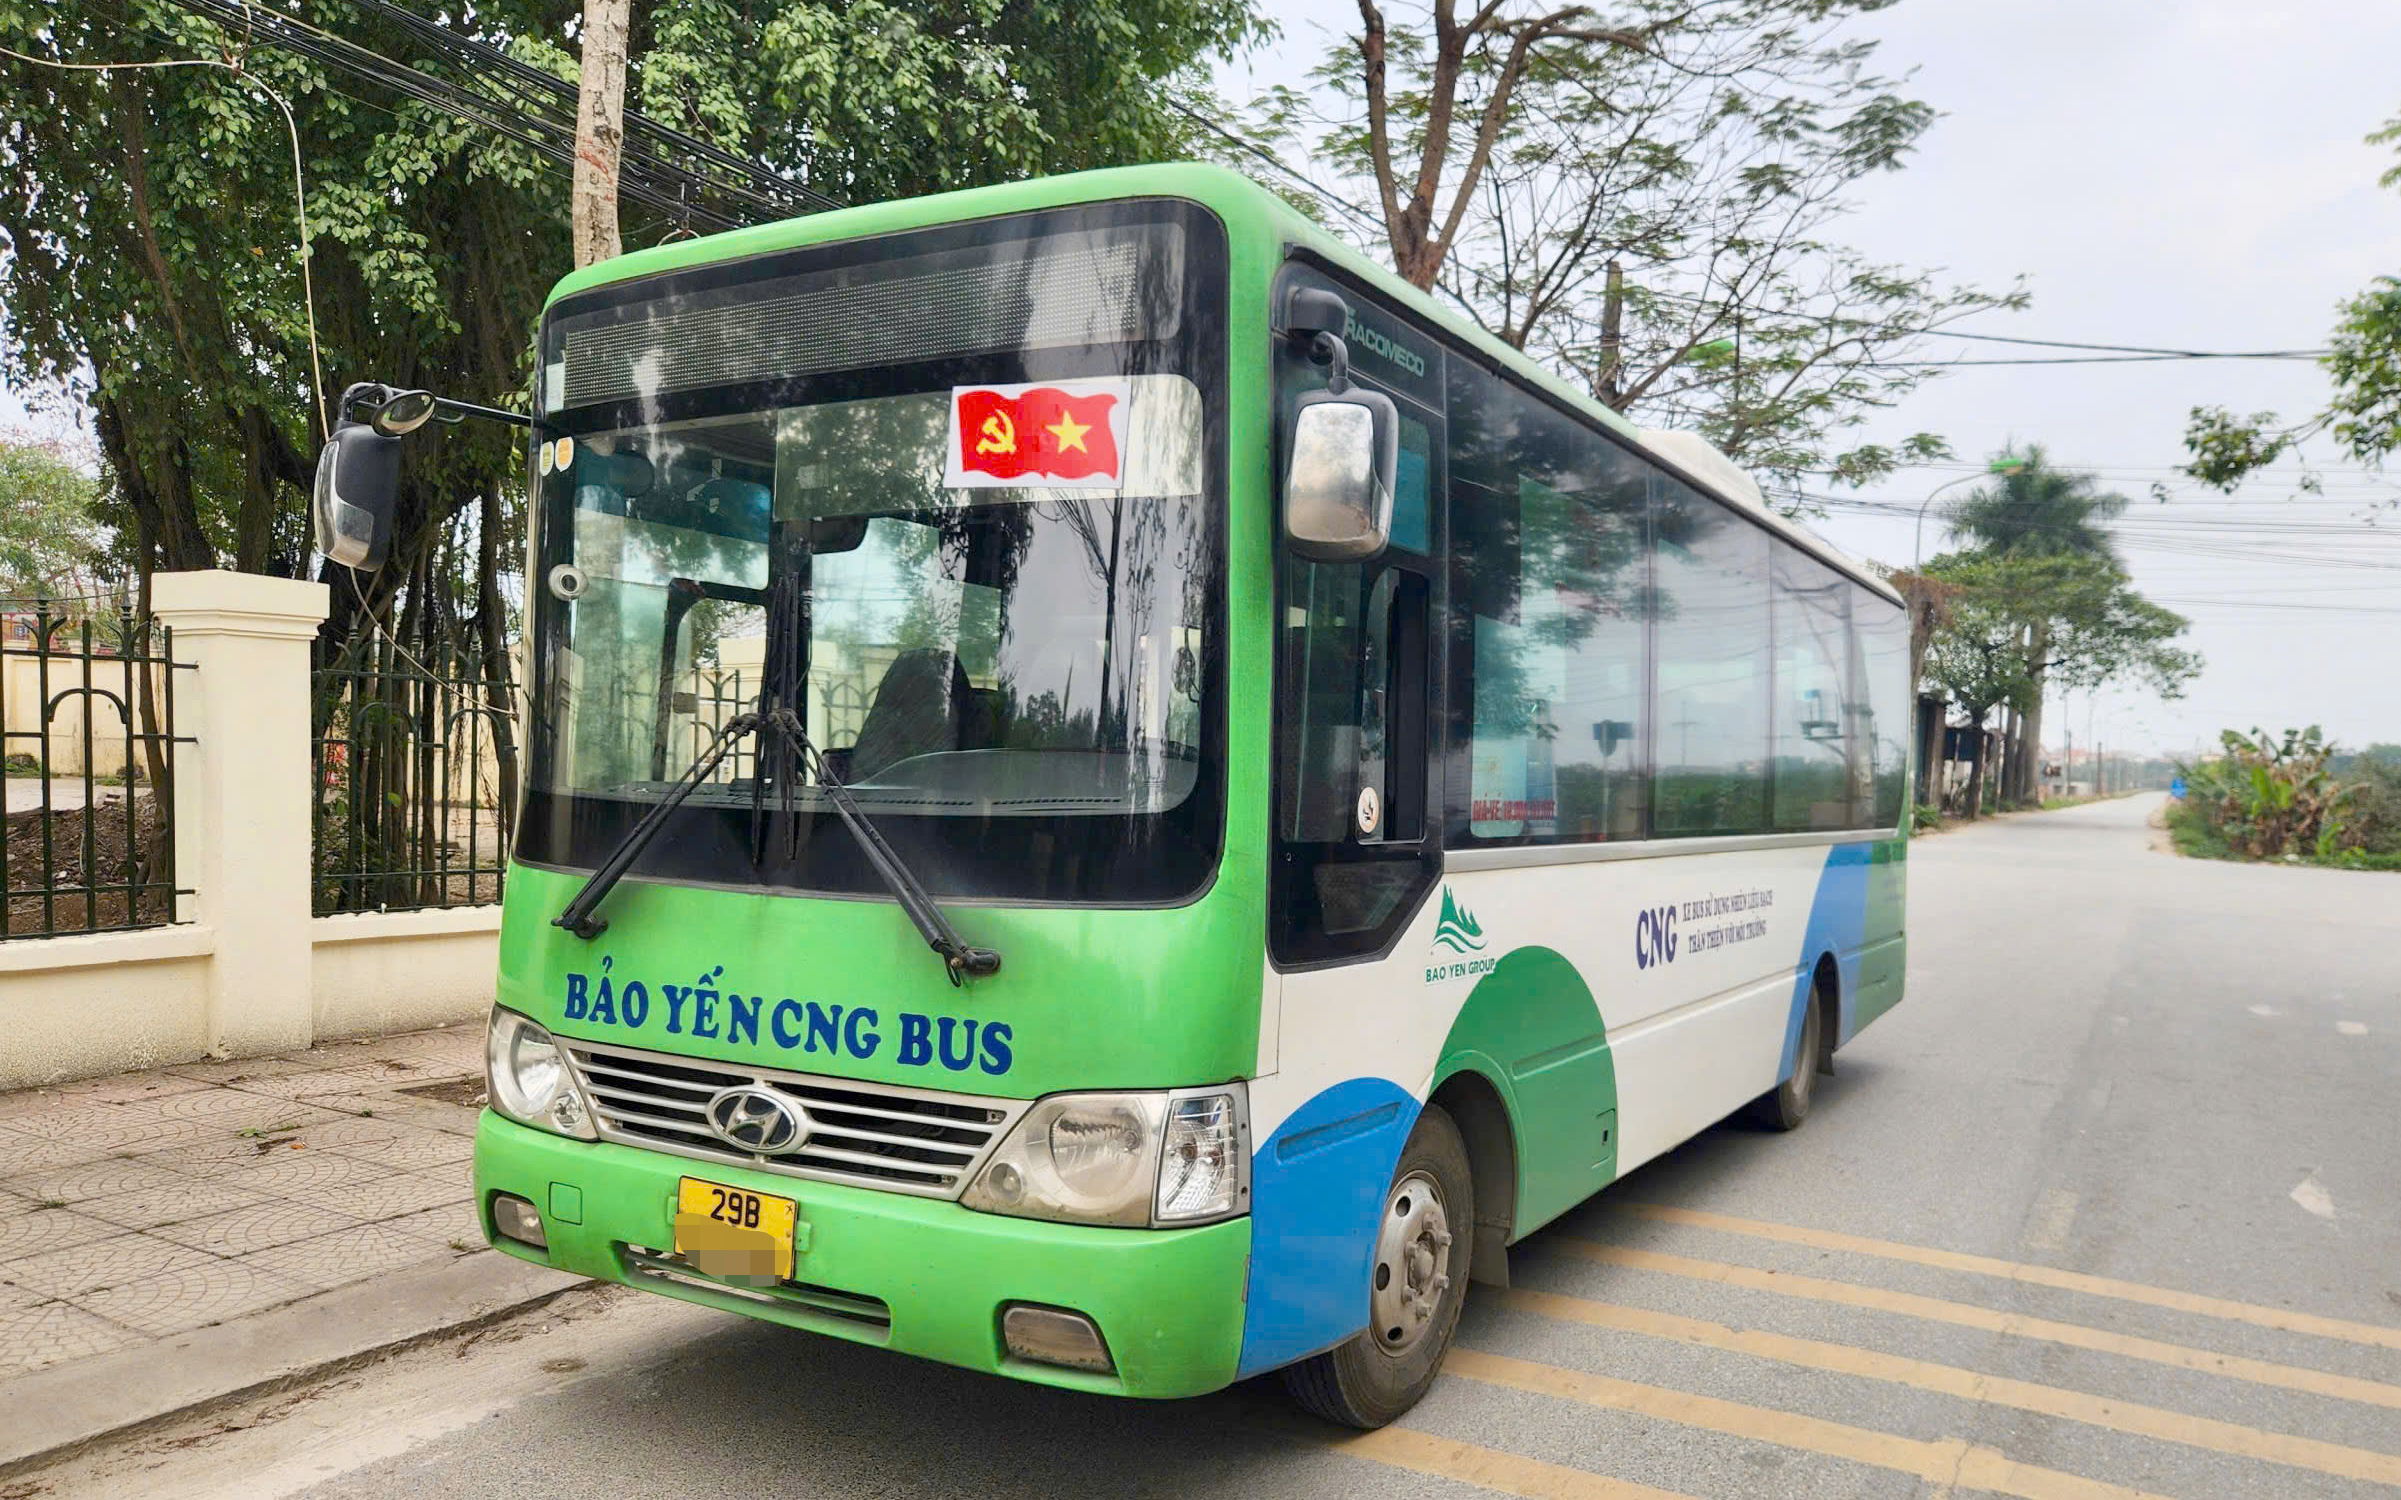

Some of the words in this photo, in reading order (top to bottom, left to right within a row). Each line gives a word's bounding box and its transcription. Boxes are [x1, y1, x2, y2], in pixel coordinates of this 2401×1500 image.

[1346, 308, 1424, 377] RACOMECO
[1426, 966, 1446, 982] BAO
[1449, 962, 1466, 978] YEN
[1468, 958, 1495, 974] GROUP
[1636, 905, 1677, 970] CNG
[564, 955, 649, 1028] BẢO
[661, 965, 763, 1046] YẾN
[771, 998, 881, 1060] CNG
[896, 1012, 1013, 1076] BUS
[710, 1188, 760, 1229] 29B
